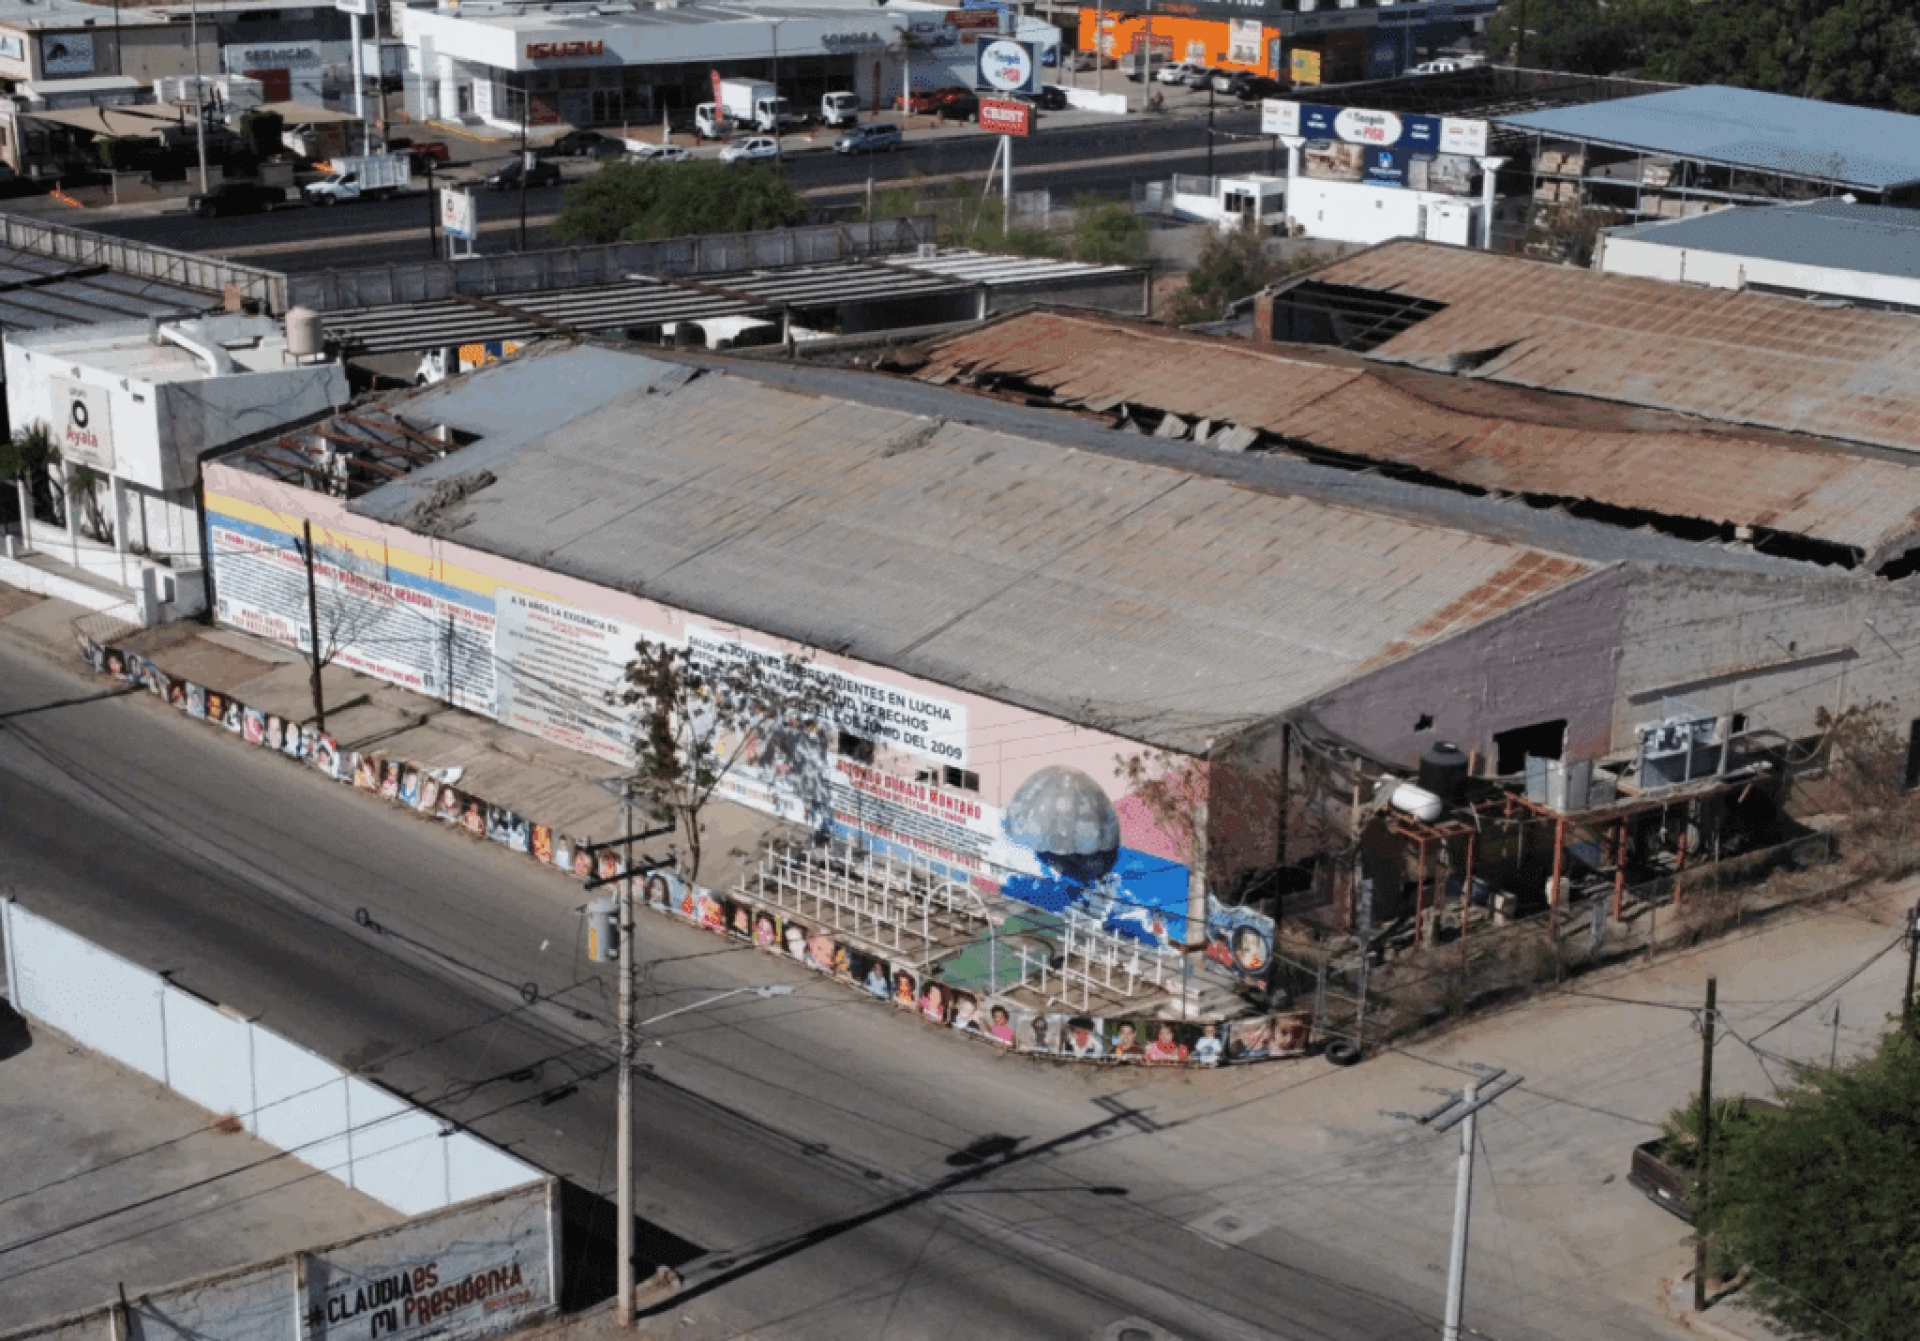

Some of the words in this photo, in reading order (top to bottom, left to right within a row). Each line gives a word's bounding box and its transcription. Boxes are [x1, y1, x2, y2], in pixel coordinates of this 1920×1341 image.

[245, 47, 312, 62] SERVICIO
[526, 40, 603, 59] ISUZU
[67, 425, 98, 449] Ayala
[551, 606, 562, 617] LA
[563, 610, 606, 630] EXIGENCIA
[860, 701, 929, 732] DERECHOS
[888, 691, 905, 707] EN
[908, 697, 952, 721] LUCHA
[903, 732, 927, 751] DEL
[930, 740, 963, 761] 2009
